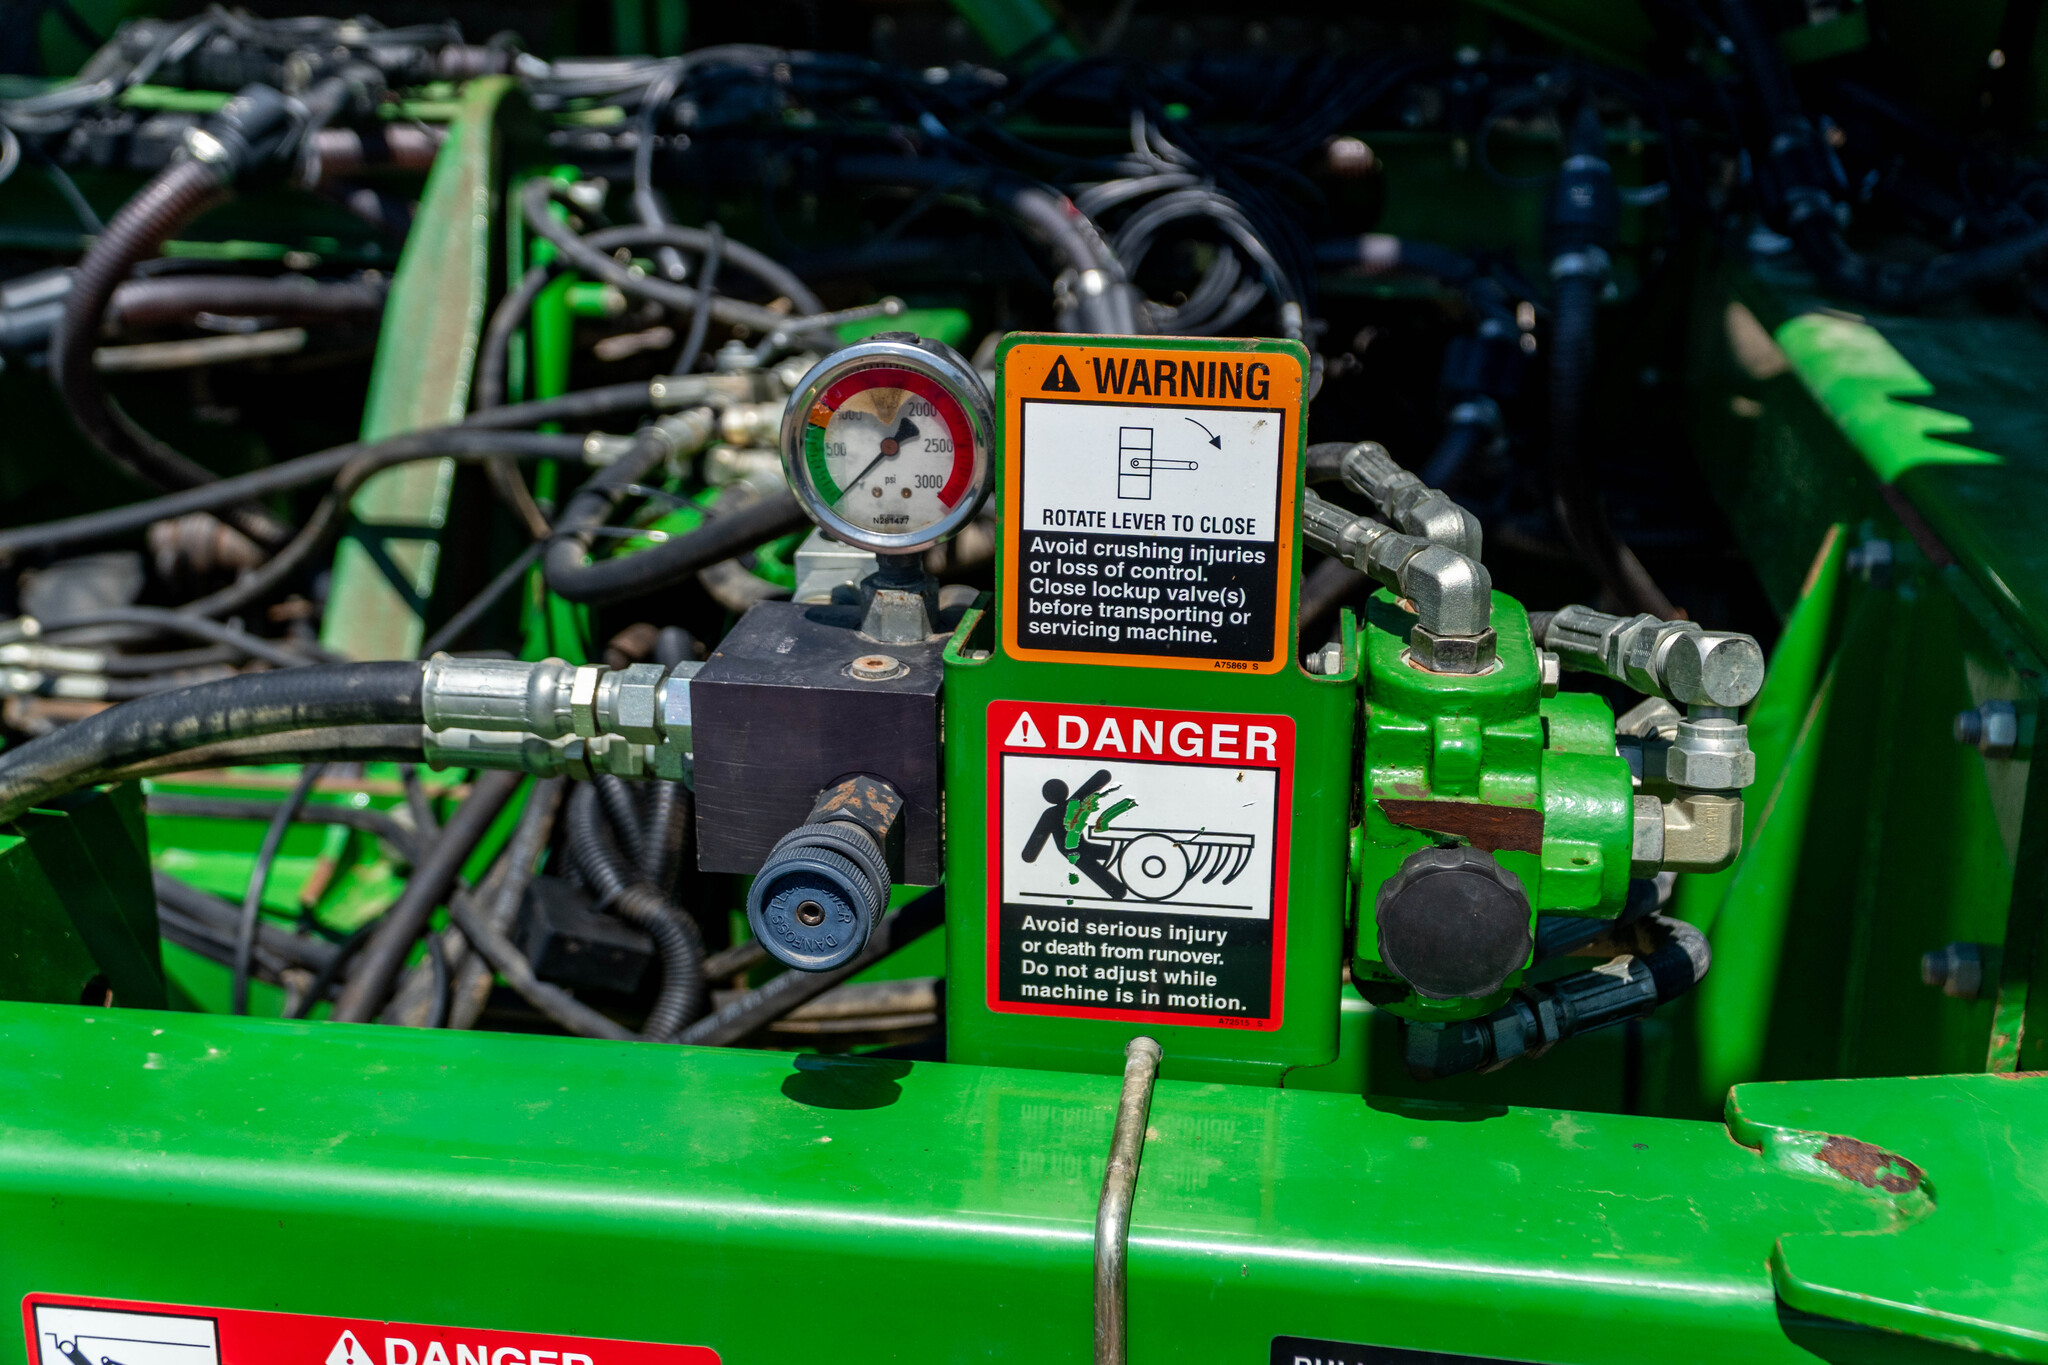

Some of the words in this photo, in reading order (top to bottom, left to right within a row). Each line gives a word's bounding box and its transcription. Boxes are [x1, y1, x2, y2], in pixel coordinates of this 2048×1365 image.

[1093, 357, 1270, 400] WARNING
[909, 402, 937, 416] 2000
[826, 442, 846, 456] 500
[924, 438, 953, 453] 2500
[885, 474, 896, 485] psi
[915, 474, 943, 488] 3000
[1043, 509, 1106, 529] ROTATE
[1112, 512, 1166, 531] LEVER
[1172, 515, 1194, 532] TO
[1200, 516, 1256, 535] CLOSE
[1030, 537, 1087, 555] Avoid
[1094, 542, 1183, 563] crushing
[1190, 545, 1266, 565] injuries
[1030, 560, 1051, 574] or
[1057, 559, 1098, 576] loss
[1104, 562, 1125, 577] of
[1131, 565, 1208, 581] control.
[1030, 578, 1086, 595] Close
[1092, 581, 1160, 603] lockup
[1166, 586, 1246, 608] valve(s)
[1029, 598, 1093, 616] before
[1099, 602, 1223, 627] transporting
[1230, 611, 1251, 625] or
[1029, 621, 1120, 642] servicing
[1127, 625, 1218, 643] machine.
[1214, 661, 1247, 670] A75869
[1058, 714, 1277, 761] DANGER
[771, 914, 839, 953] DANFOSS
[1021, 915, 1079, 933] Avoid
[1086, 921, 1162, 939] serious
[1169, 925, 1228, 946] injury
[1021, 941, 1041, 953] or
[1045, 939, 1096, 957] death
[1100, 943, 1143, 960] from
[1148, 948, 1224, 965] runover.
[1021, 959, 1048, 976] Do
[1055, 963, 1088, 979] not
[1094, 966, 1158, 984] adjust
[1163, 970, 1217, 987] while
[1021, 983, 1108, 1001] machine
[1116, 987, 1134, 1003] is
[1141, 989, 1160, 1005] in
[1167, 994, 1247, 1011] motion.
